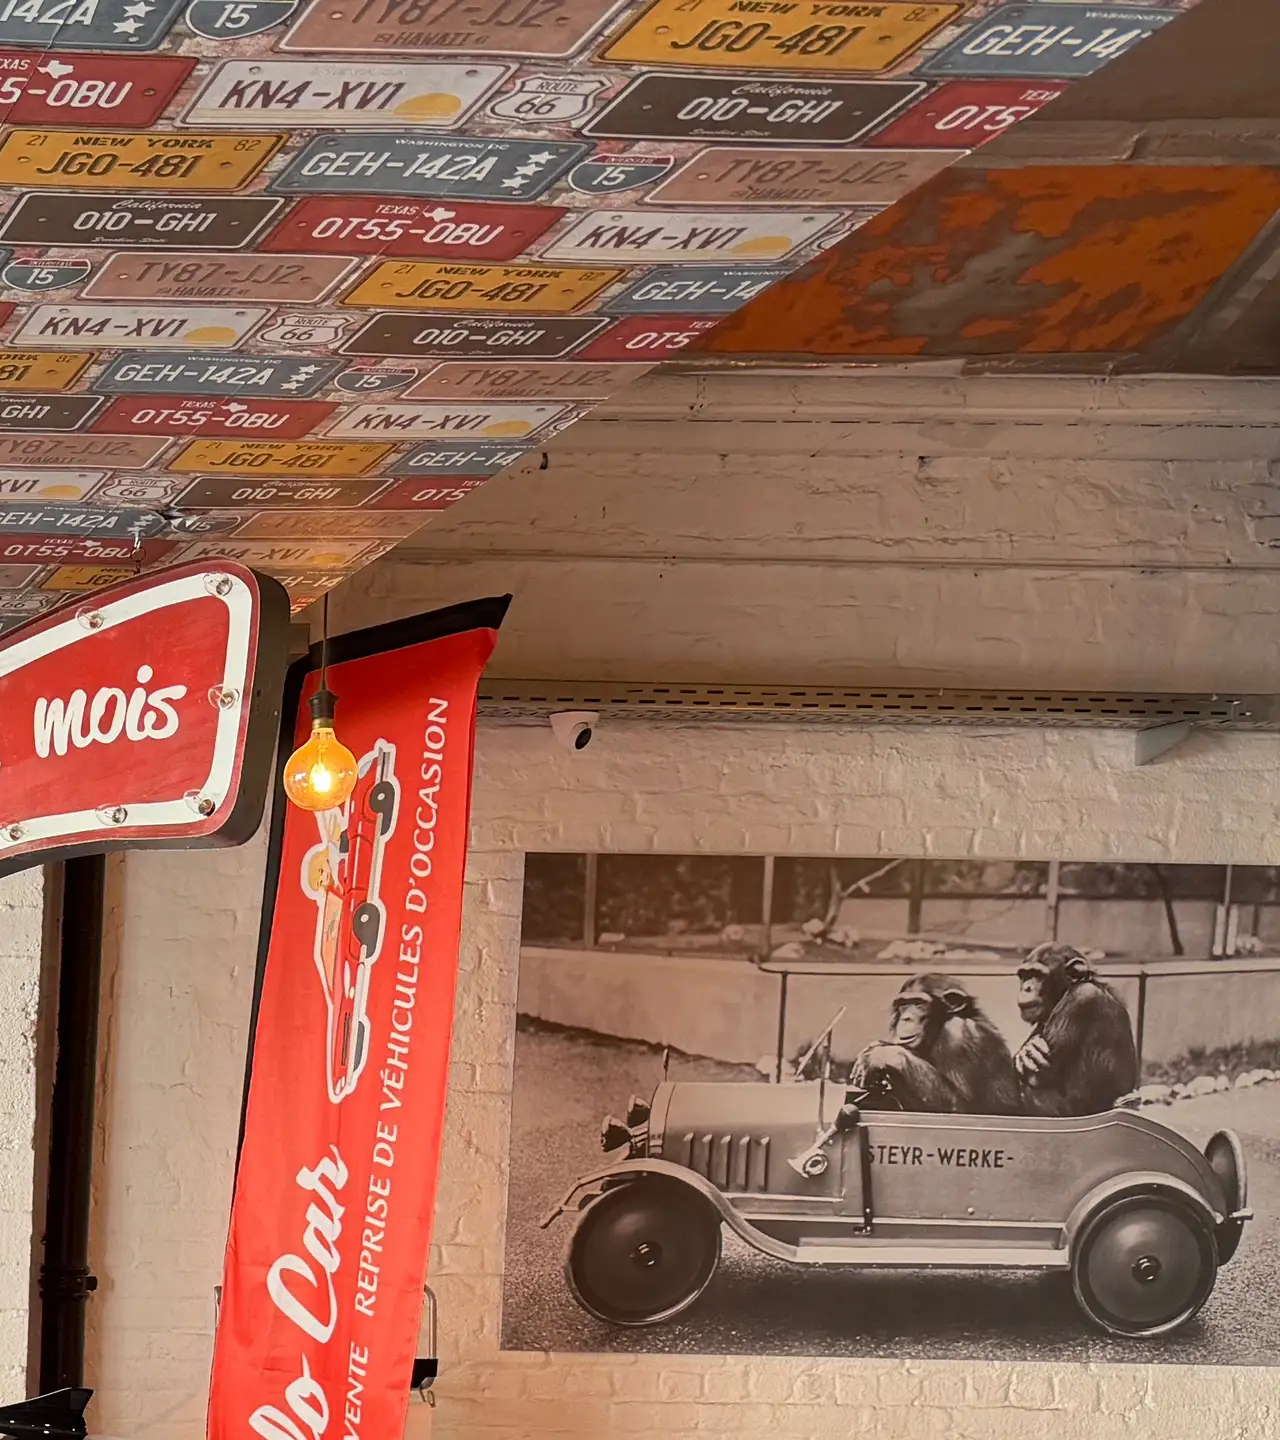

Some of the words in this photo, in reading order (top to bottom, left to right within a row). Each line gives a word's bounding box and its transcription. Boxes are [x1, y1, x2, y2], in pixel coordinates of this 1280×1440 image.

[532, 81, 584, 93] ROUTE
[728, 81, 839, 97] California
[510, 96, 567, 117] 66
[25, 135, 49, 146] 21
[72, 135, 135, 147] NEW
[140, 137, 218, 150] YORK
[232, 140, 263, 152] 82
[297, 151, 506, 182] GEH-142A
[588, 165, 637, 186] 15
[370, 204, 421, 216] TEXAS
[33, 664, 188, 760] mois
[380, 922, 424, 1113] VÉHICULES
[375, 1120, 398, 1168] DE
[266, 1143, 350, 1345] Car
[354, 1172, 392, 1317] REPRISE
